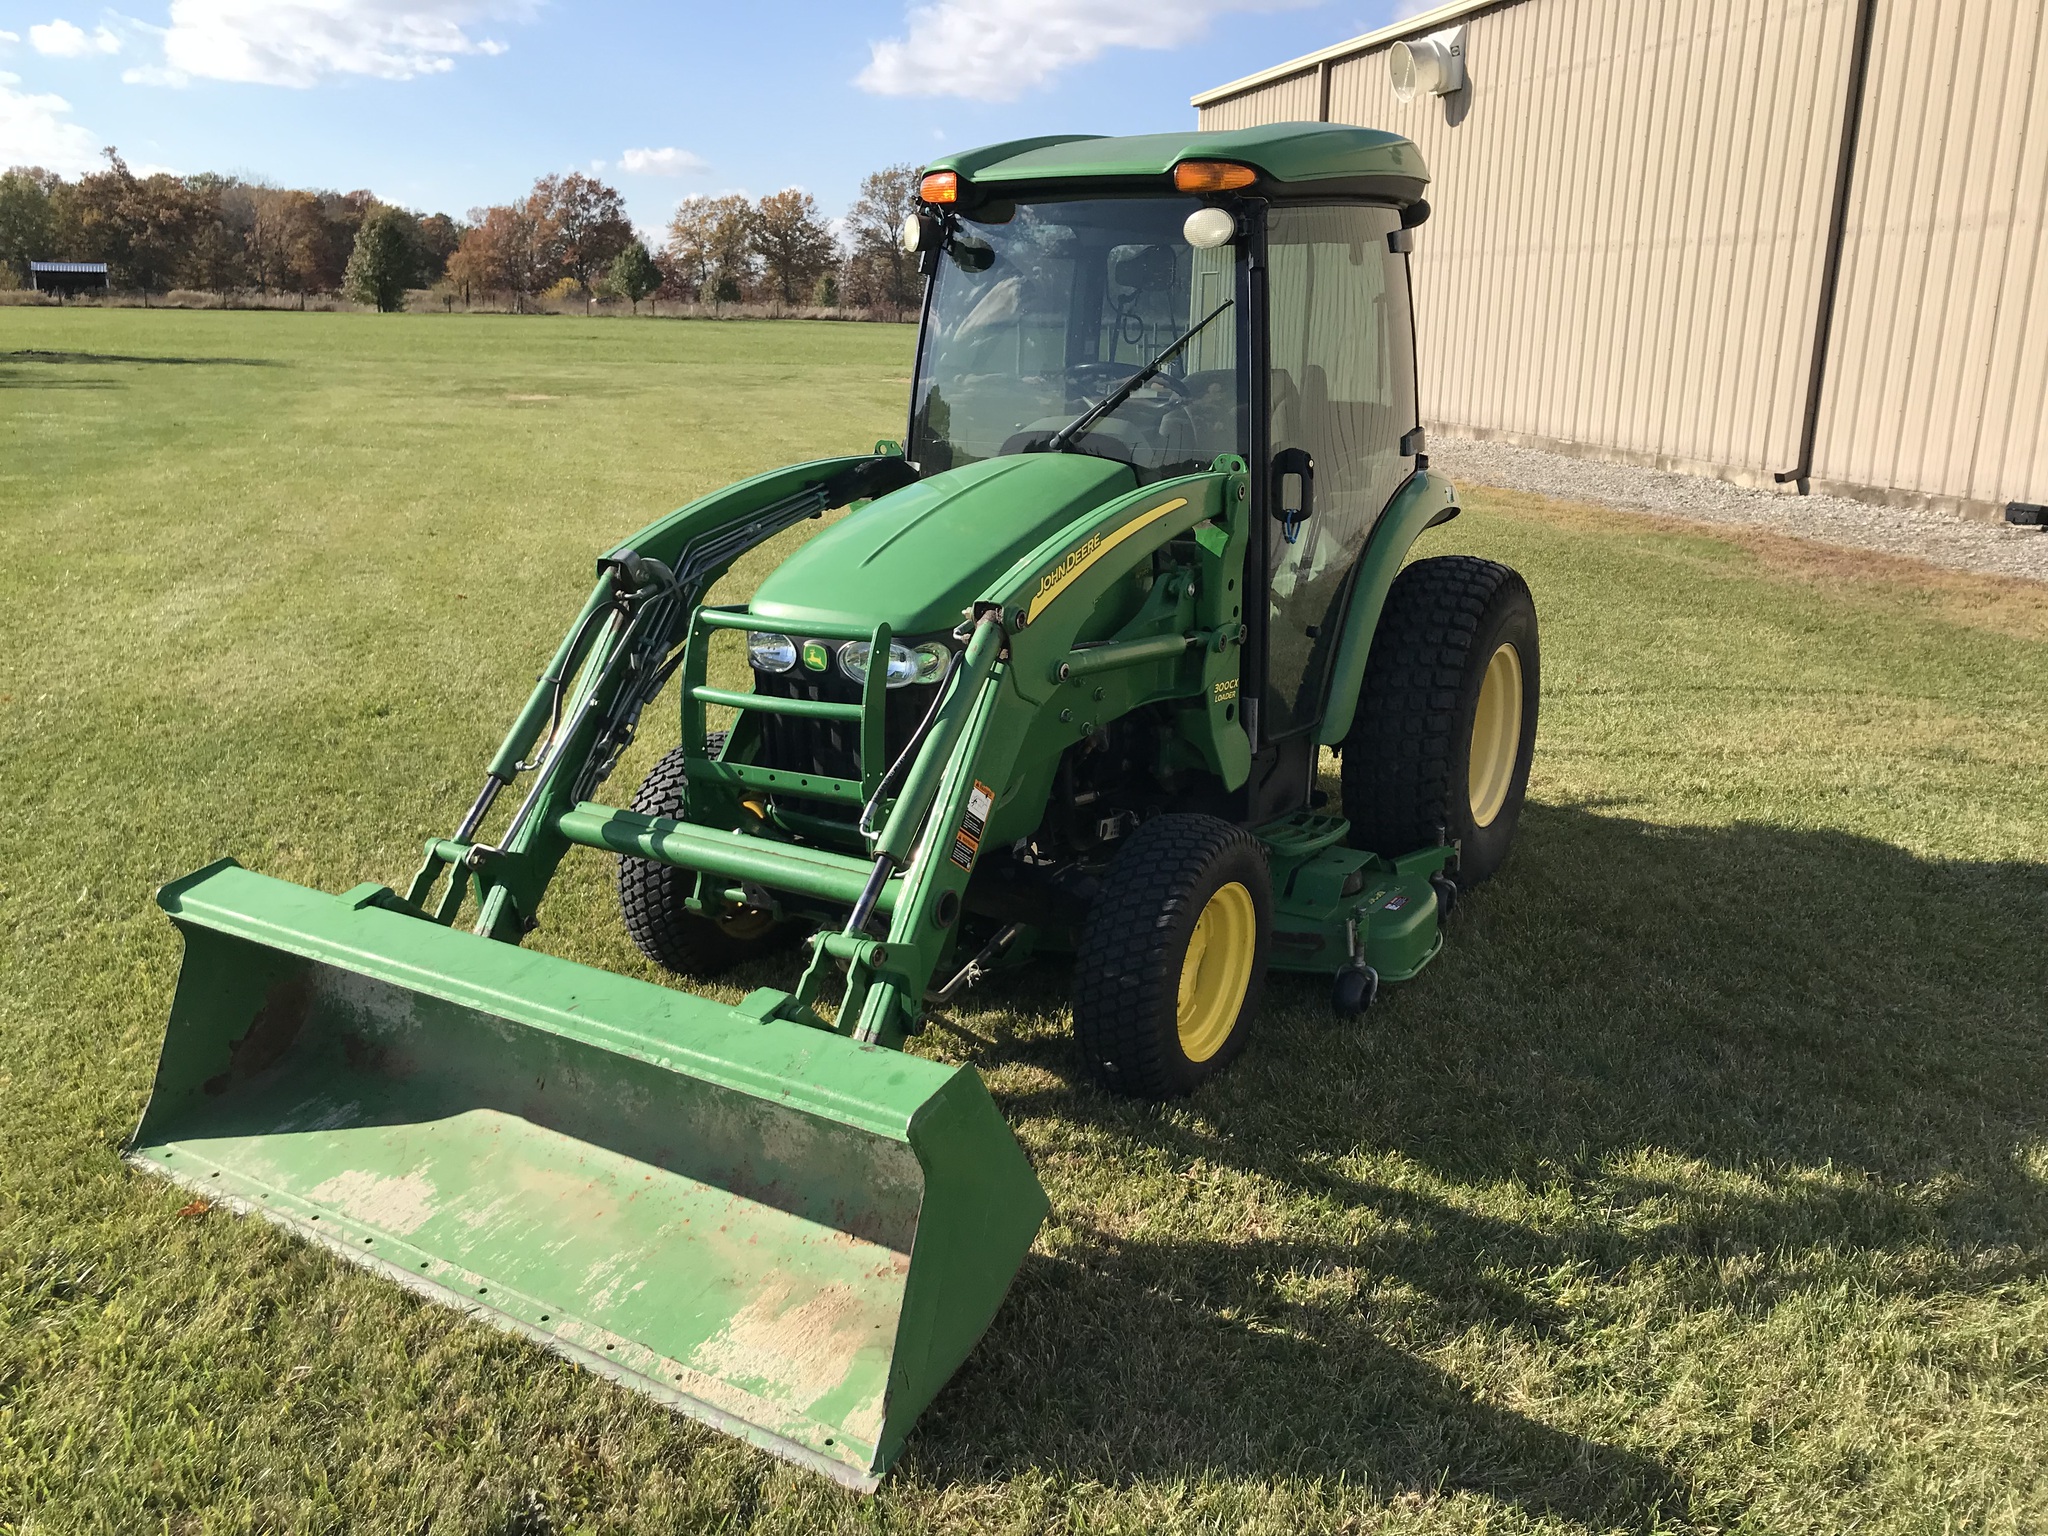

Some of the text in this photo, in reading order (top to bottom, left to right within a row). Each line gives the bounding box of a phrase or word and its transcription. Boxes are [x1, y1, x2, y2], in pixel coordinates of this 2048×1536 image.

[1036, 532, 1101, 598] JOHN DEERE
[1213, 677, 1240, 693] 300CX
[1214, 690, 1236, 703] LOADER
